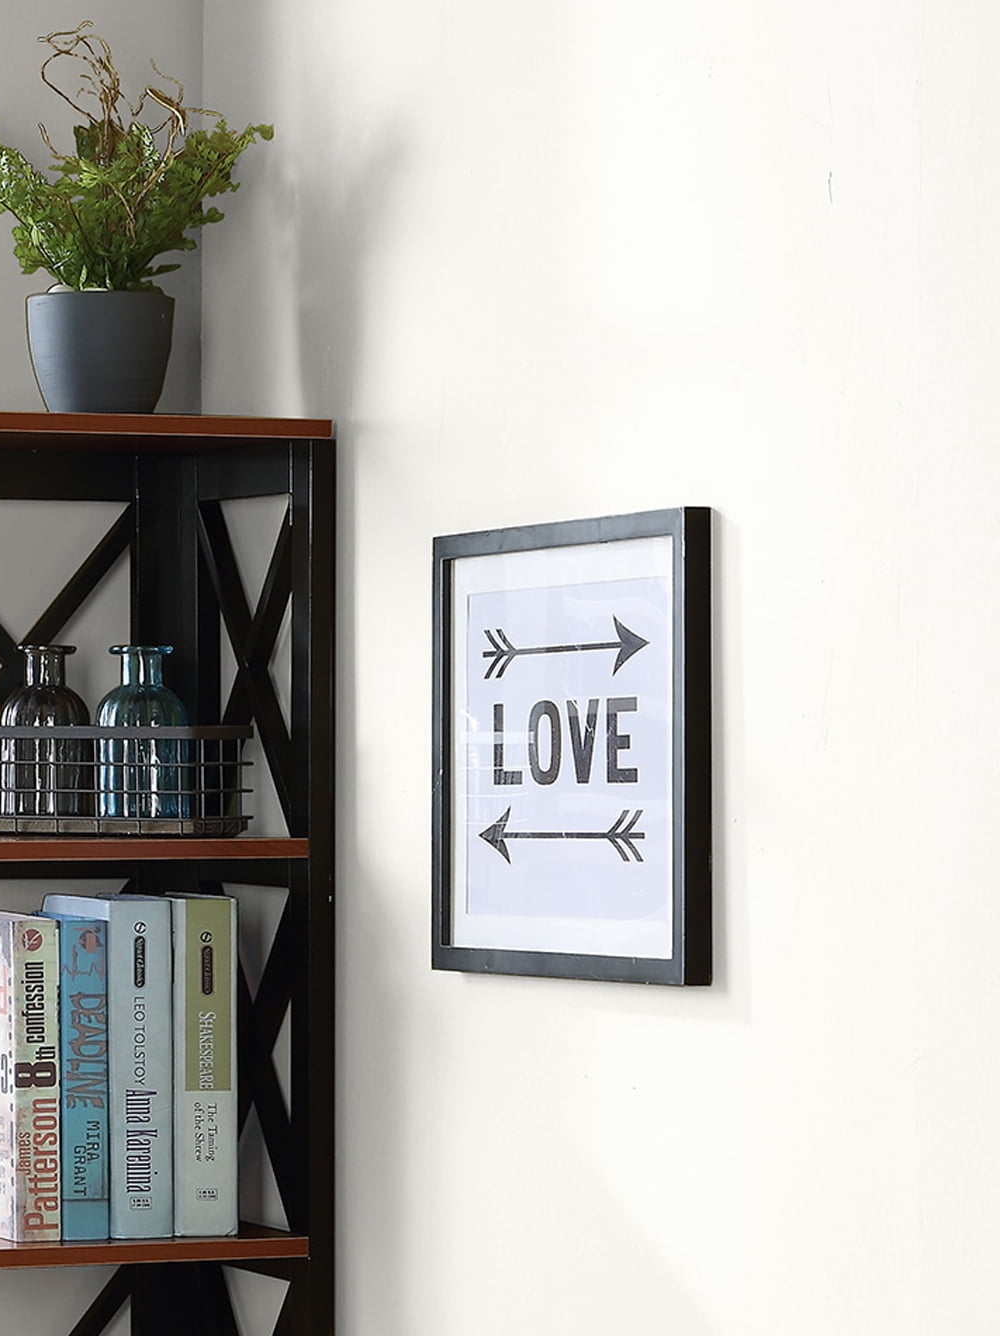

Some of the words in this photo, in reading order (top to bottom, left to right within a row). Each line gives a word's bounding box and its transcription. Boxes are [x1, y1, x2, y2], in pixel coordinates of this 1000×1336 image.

[493, 697, 638, 785] LOVE
[21, 961, 45, 1043] confession
[134, 996, 145, 1021] LEO
[15, 1046, 56, 1088] 8th
[66, 992, 108, 1109] DEADLINE
[134, 1027, 145, 1086] TOLSTOY
[199, 1011, 217, 1090] SHAKESPEARE
[126, 1089, 157, 1123] Anna
[207, 1103, 217, 1122] The
[16, 1132, 31, 1175] James
[24, 1098, 59, 1230] Patterson
[86, 1120, 100, 1161] MIRA
[126, 1129, 158, 1193] Karenina
[194, 1132, 205, 1162] Shrew
[205, 1126, 218, 1161] Taming
[73, 1145, 87, 1196] GRANT
